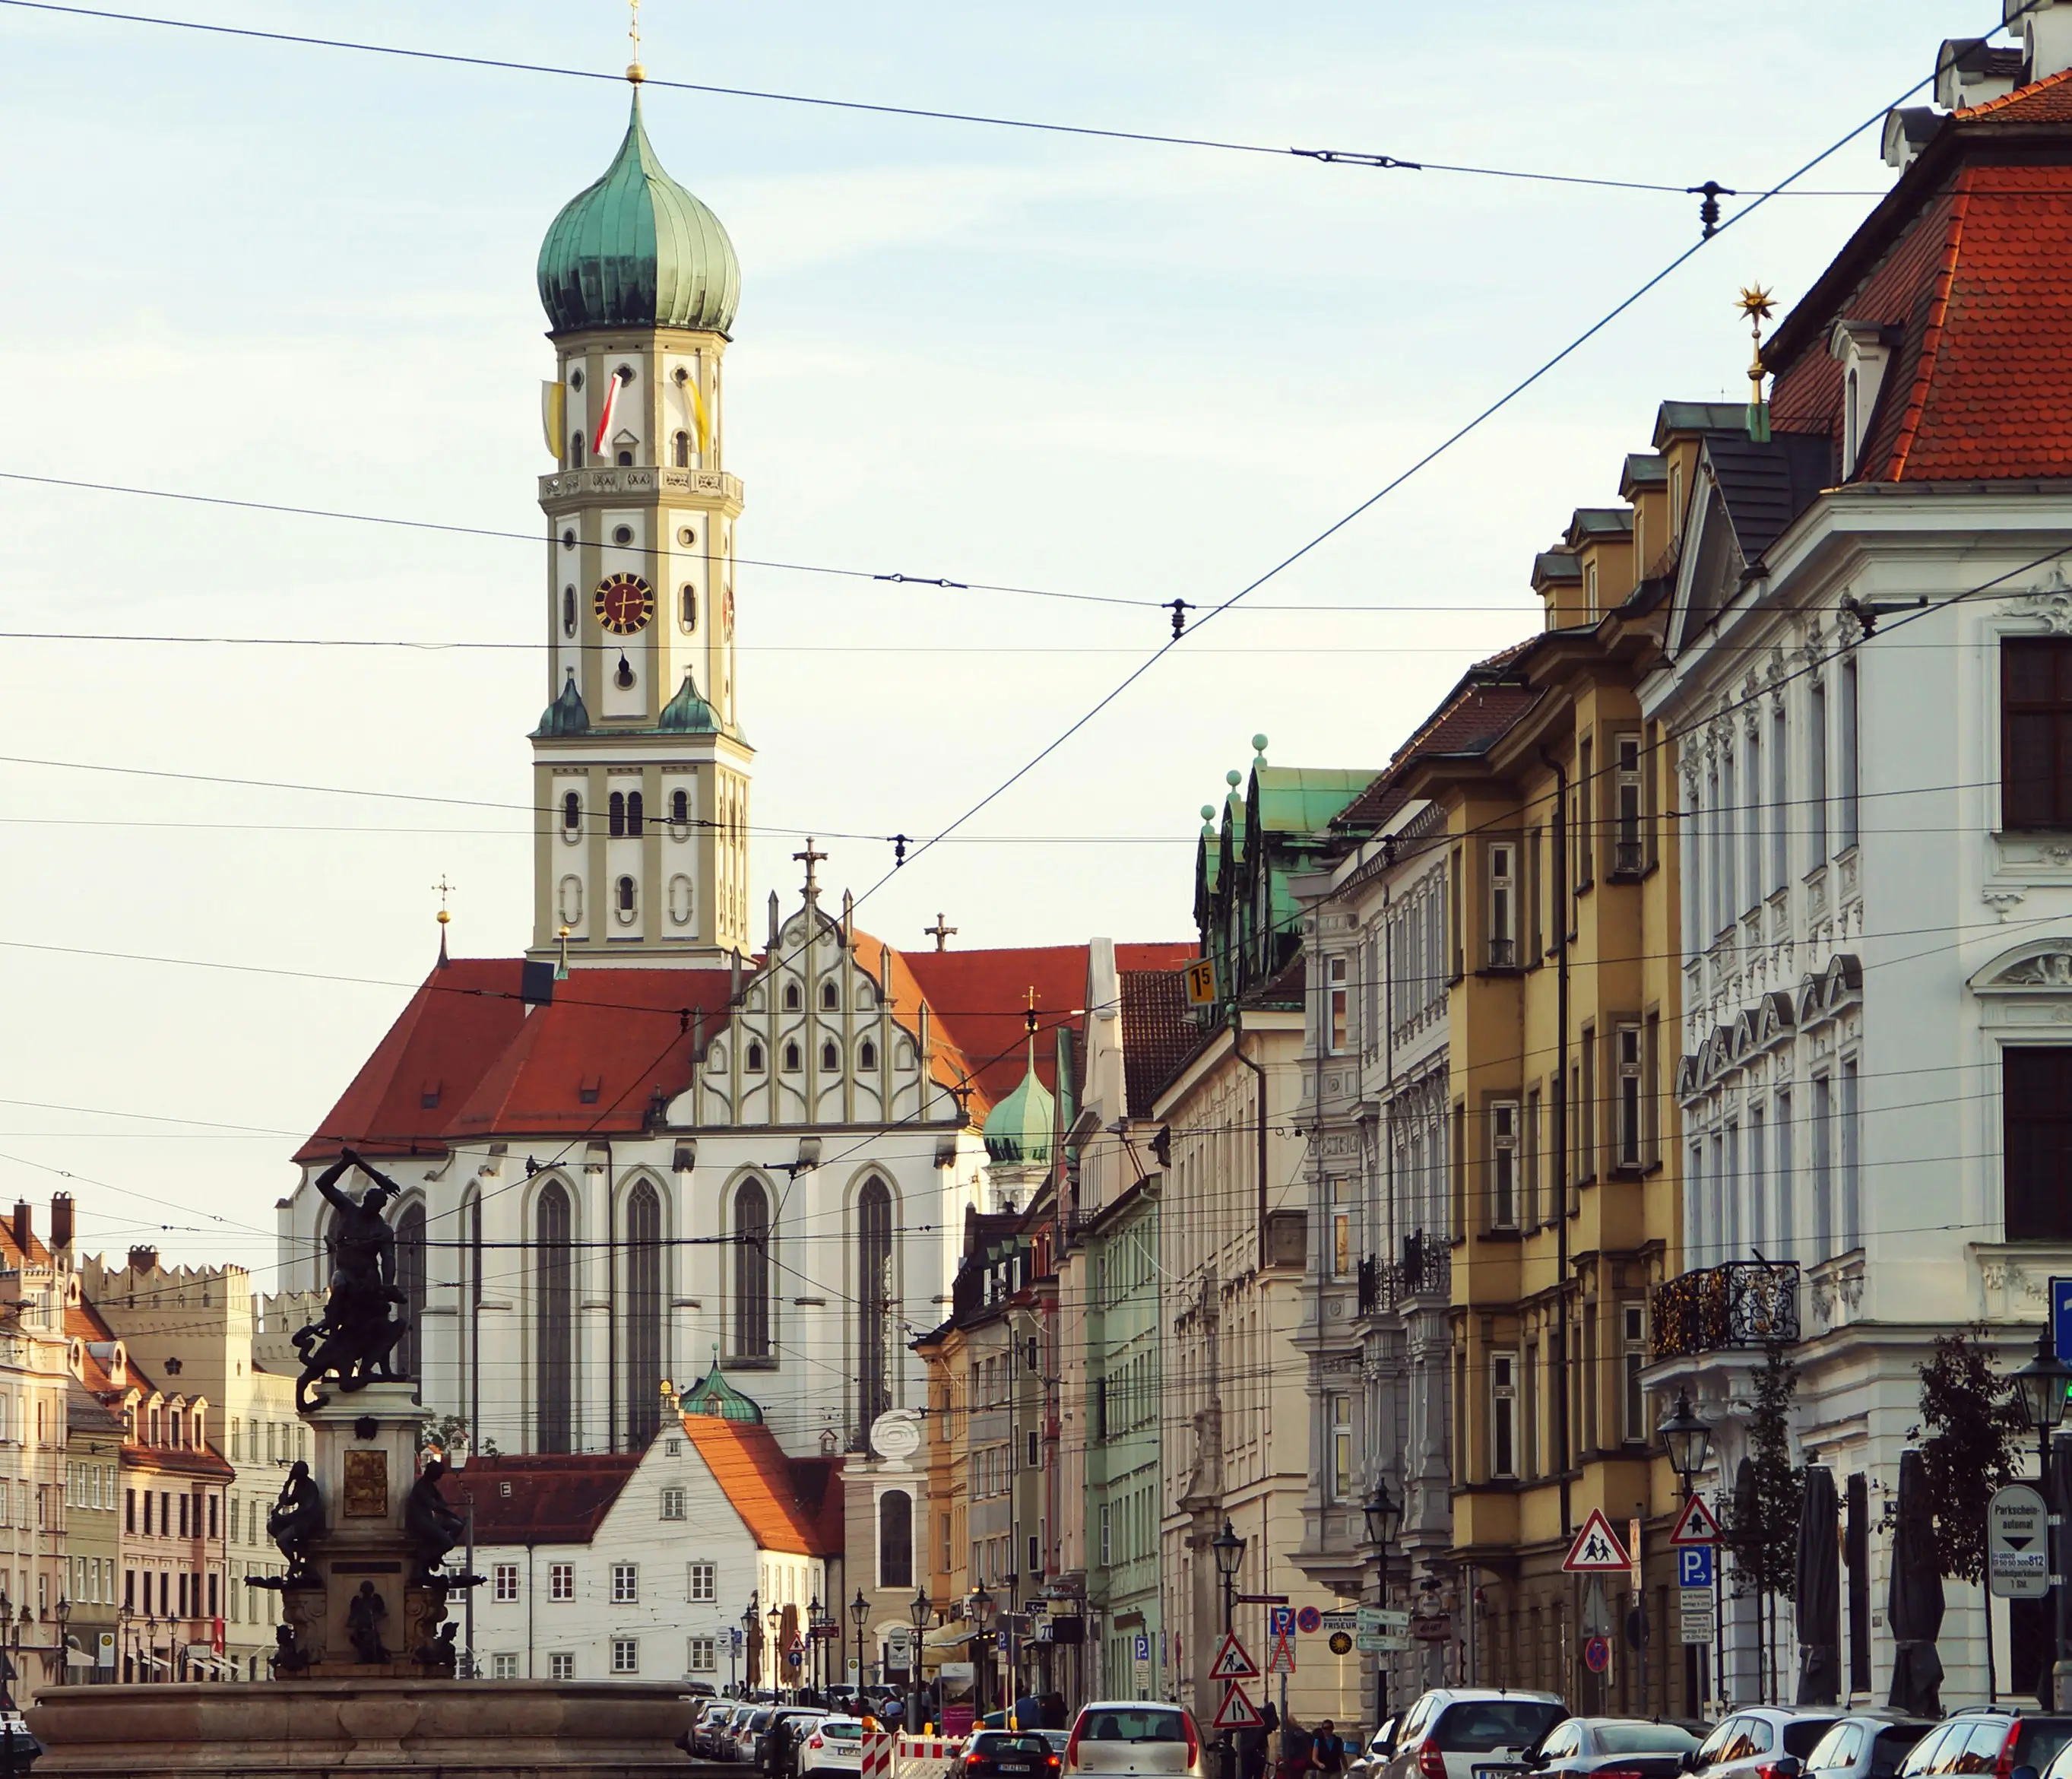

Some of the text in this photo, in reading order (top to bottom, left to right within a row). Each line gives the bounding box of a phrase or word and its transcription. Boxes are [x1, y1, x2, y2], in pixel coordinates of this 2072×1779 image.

[1995, 1505, 2040, 1515] Parkschein-
[2002, 1521, 2033, 1530] automat
[1684, 1551, 1702, 1582] P
[2029, 1555, 2044, 1567] 812
[1137, 1640, 1145, 1658] P
